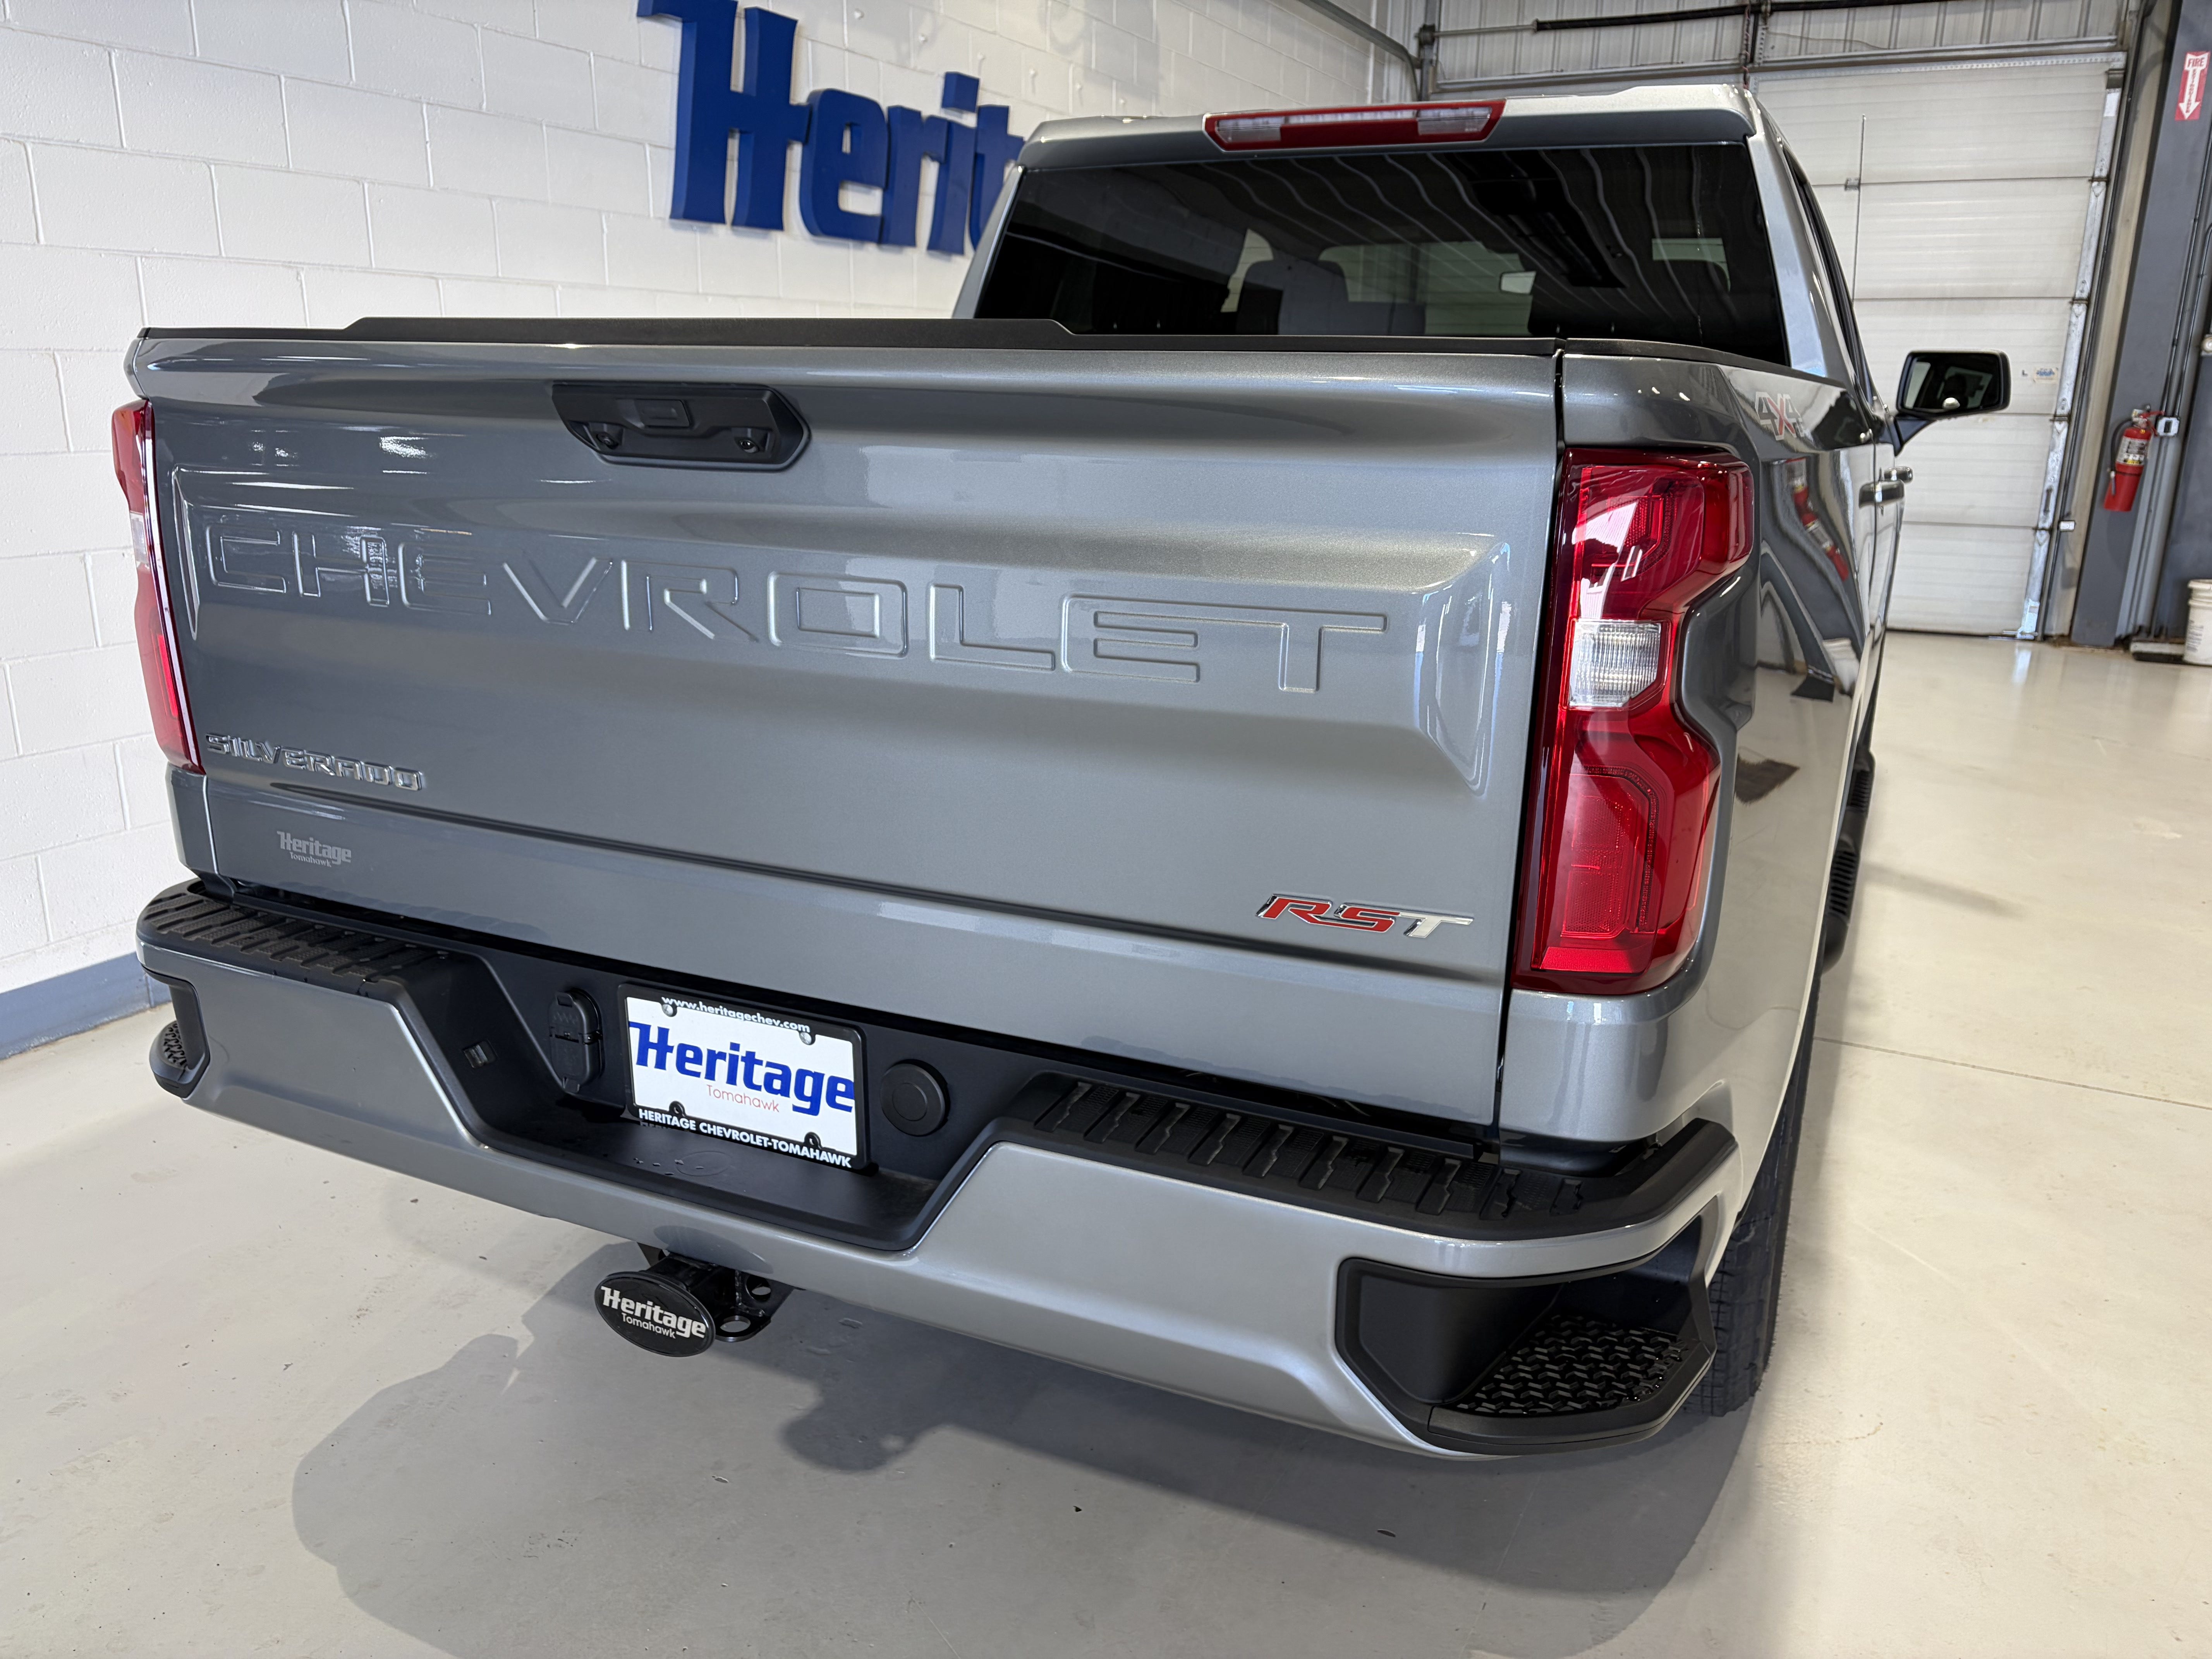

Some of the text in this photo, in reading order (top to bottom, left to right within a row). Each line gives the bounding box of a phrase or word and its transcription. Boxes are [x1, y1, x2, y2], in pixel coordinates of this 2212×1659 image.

[2188, 57, 2205, 67] FIRE
[205, 524, 1388, 693] CHEVROLET
[206, 733, 423, 791] SILVERADO
[277, 831, 351, 865] Heritage
[290, 852, 331, 867] Tomahawk
[1255, 893, 1474, 938] RST
[661, 996, 810, 1032] www.heritagechev.com
[629, 1021, 854, 1116] Heritage
[706, 1084, 779, 1113] Tomahawk
[639, 1109, 852, 1168] HERITAGE CHEVROLET-TOMAHAWK
[601, 1286, 706, 1338] Heritage
[622, 1313, 676, 1339] Tomahawk
